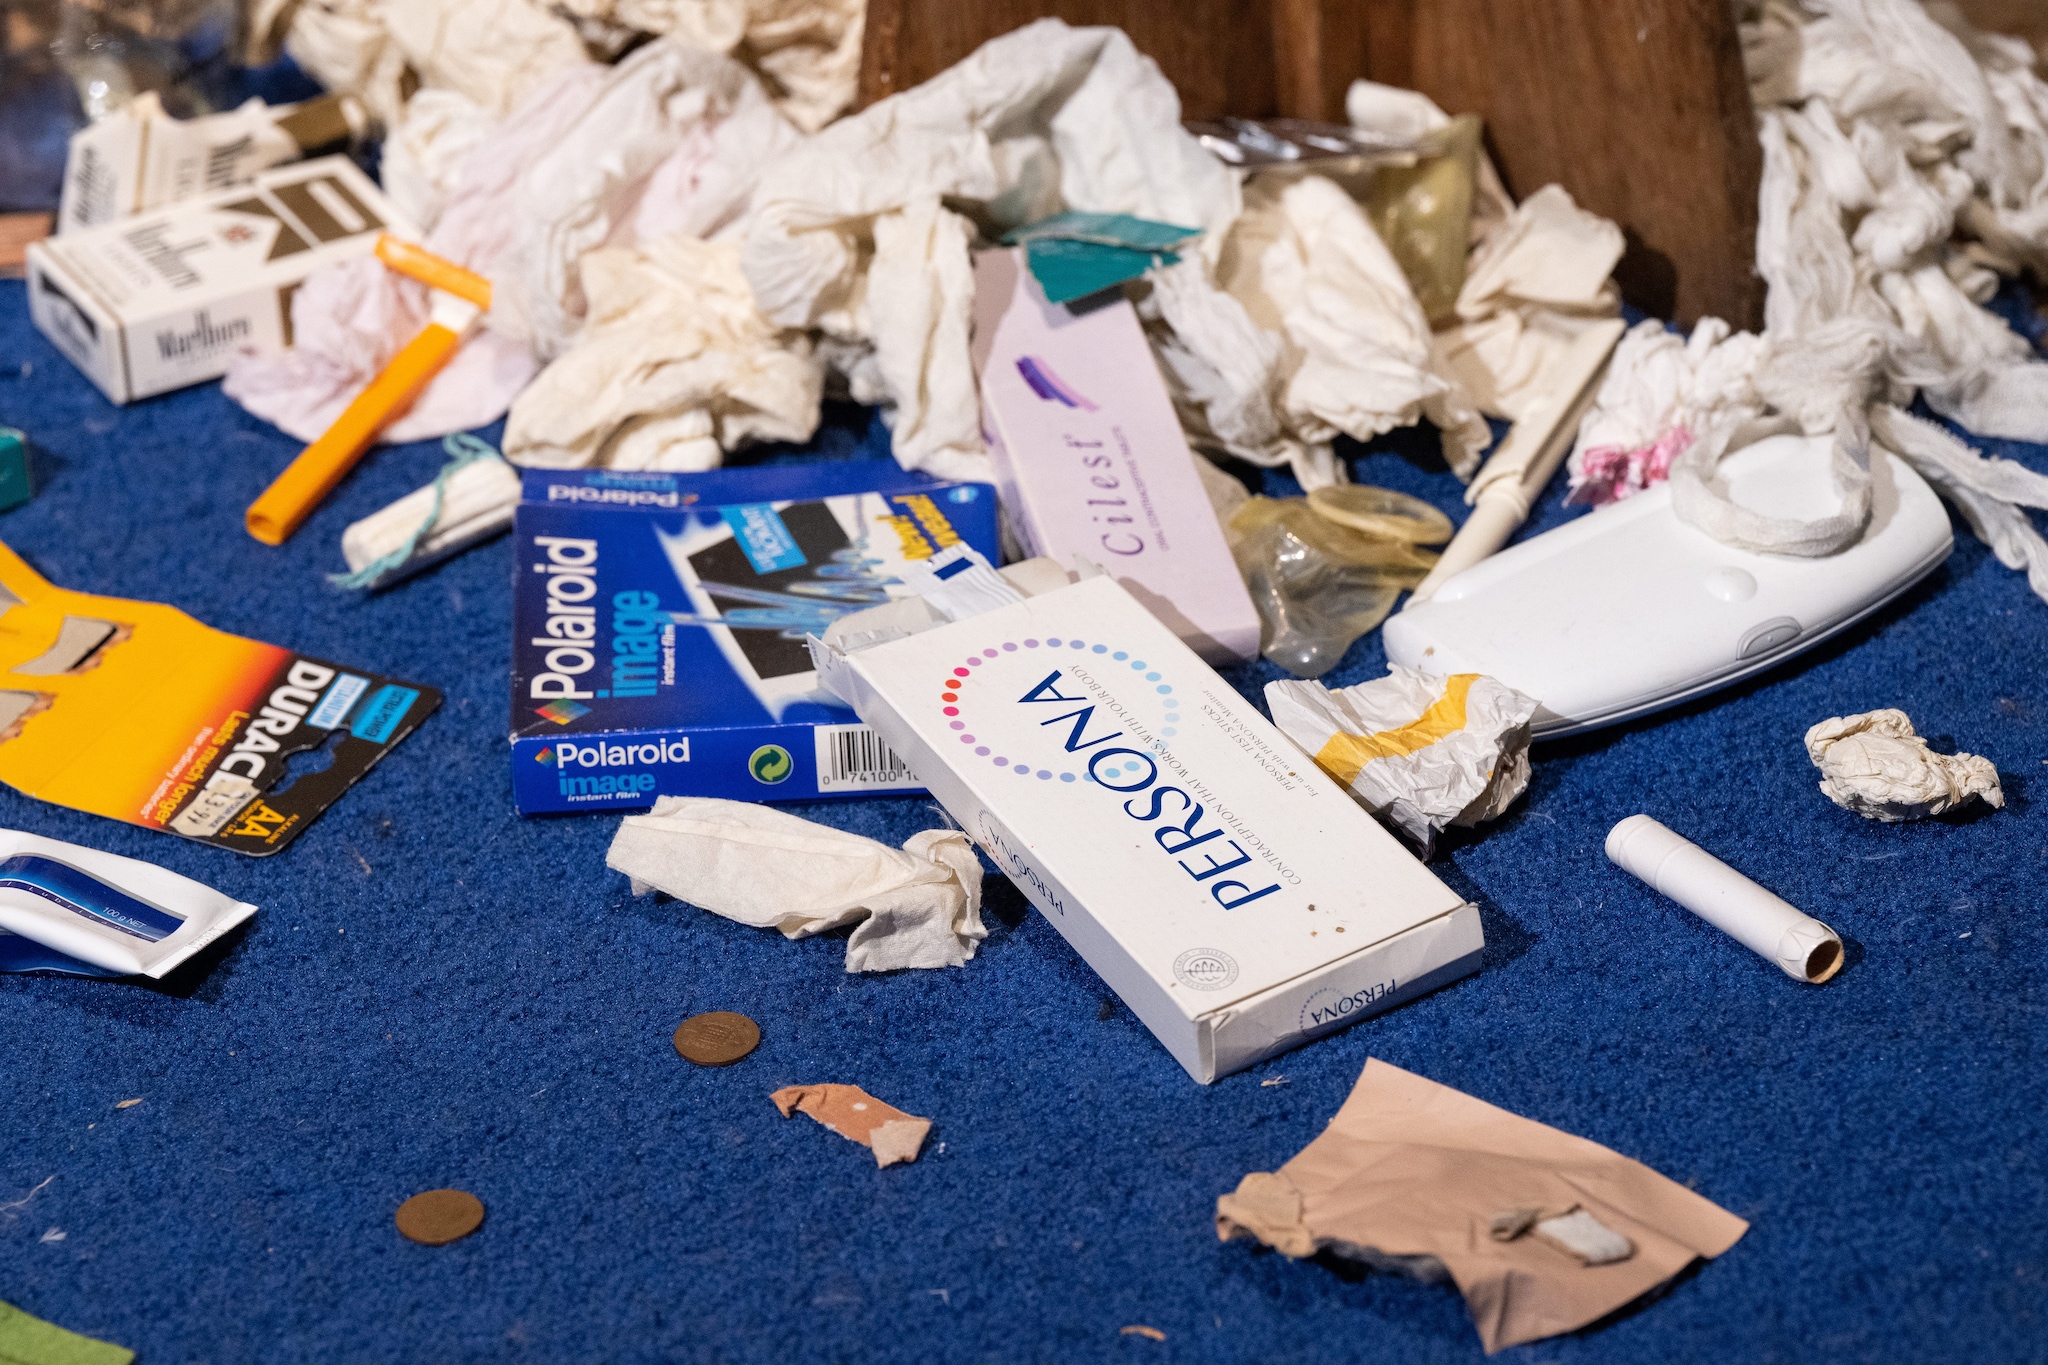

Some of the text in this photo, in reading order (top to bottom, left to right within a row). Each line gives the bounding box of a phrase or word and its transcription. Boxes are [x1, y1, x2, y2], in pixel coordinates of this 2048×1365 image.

[548, 484, 679, 507] Polaroid
[530, 536, 598, 699] Polaroid
[596, 590, 675, 698] image
[1067, 662, 1102, 690] BODY
[1096, 688, 1127, 719] YOUR
[193, 727, 213, 747] than
[198, 659, 335, 794] DURAC
[1124, 716, 1154, 742] WITH
[1201, 688, 1319, 797] For us with PERSONA Monitor
[166, 744, 197, 779] ordinary
[556, 736, 690, 769] Polaroid
[1199, 703, 1295, 790] PERSONA TEST STICKS
[153, 710, 250, 825] Lasts much longer
[558, 771, 656, 796] image
[850, 772, 897, 783] 74100
[568, 792, 640, 802] instant film
[1018, 669, 1282, 910] PERSONA
[1184, 776, 1216, 802] THAT
[233, 804, 284, 837] AA
[264, 813, 299, 845] ALKALINE
[1211, 802, 1302, 883] CONTRACEPTION
[989, 825, 1062, 915] PERSONA
[102, 906, 120, 917] 100
[126, 917, 146, 929] NET
[1310, 978, 1396, 1024] PERSONA
